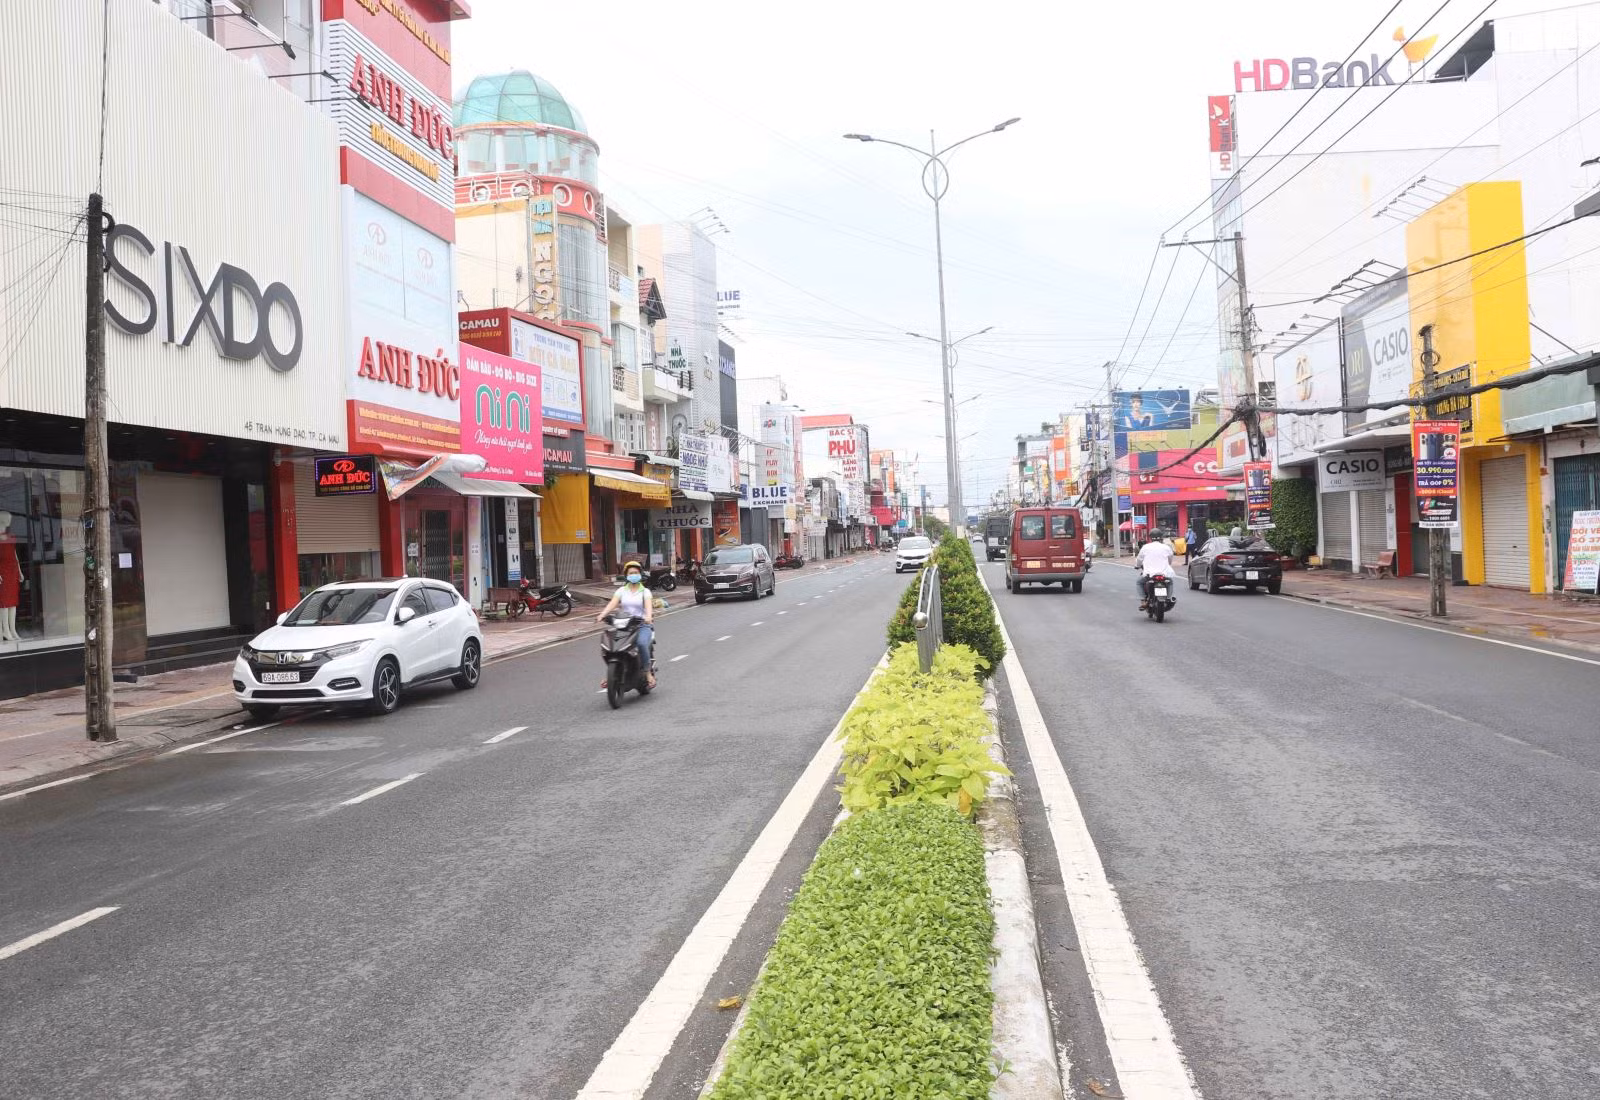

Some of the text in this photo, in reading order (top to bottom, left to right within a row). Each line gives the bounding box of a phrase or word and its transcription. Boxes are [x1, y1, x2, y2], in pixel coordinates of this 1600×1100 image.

[1234, 54, 1396, 92] HDBank
[350, 52, 405, 128] ANH
[104, 224, 302, 372] SIXDO
[717, 290, 740, 302] LUE
[460, 318, 499, 330] CAMAU
[1374, 327, 1408, 366] CASIO
[358, 336, 460, 402] ANH ĐỨC
[244, 422, 253, 430] 45
[256, 423, 272, 434] TRAN
[275, 426, 291, 436] HUNG
[329, 434, 339, 444] MAU
[1326, 459, 1379, 474] CASIO
[320, 470, 370, 485] ANH ĐỨC
[752, 486, 787, 498] BLUE
[657, 515, 710, 527] THUỐC
